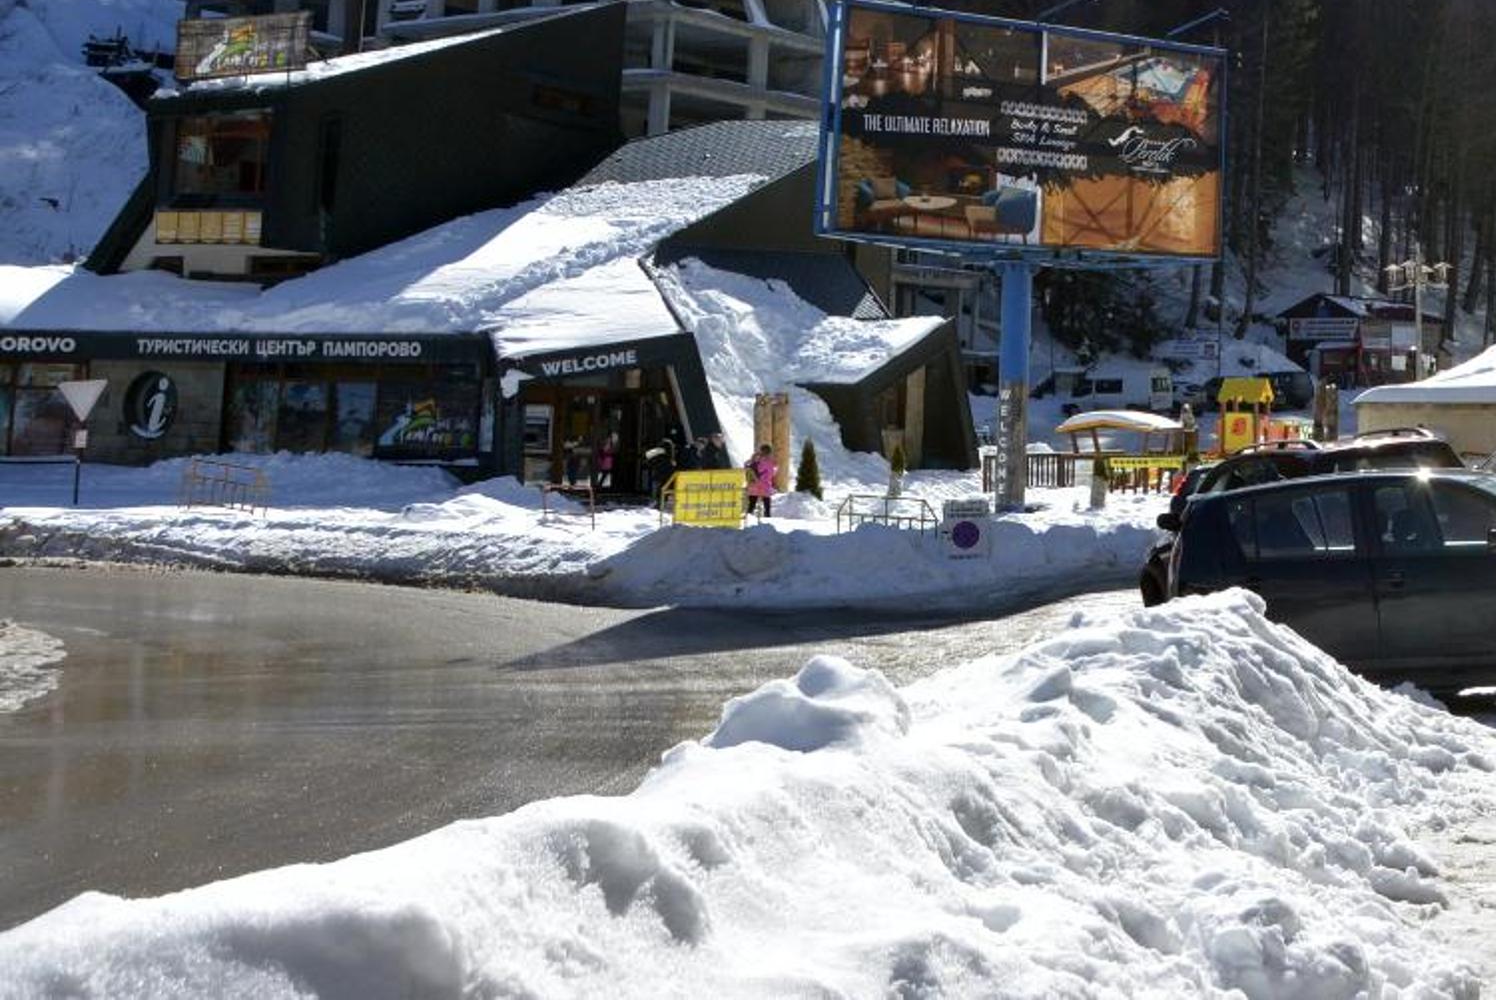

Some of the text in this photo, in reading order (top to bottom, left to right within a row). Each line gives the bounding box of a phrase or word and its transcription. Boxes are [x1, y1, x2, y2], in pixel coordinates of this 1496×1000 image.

[863, 114, 990, 138] THE ULTIMATE RELAXATION
[136, 339, 421, 357] ТУРИСТИЧЕСКИ ЦЕНТЪР ПАМПОРОВО
[541, 350, 638, 377] WELCOME
[998, 389, 1012, 494] WELCOME
